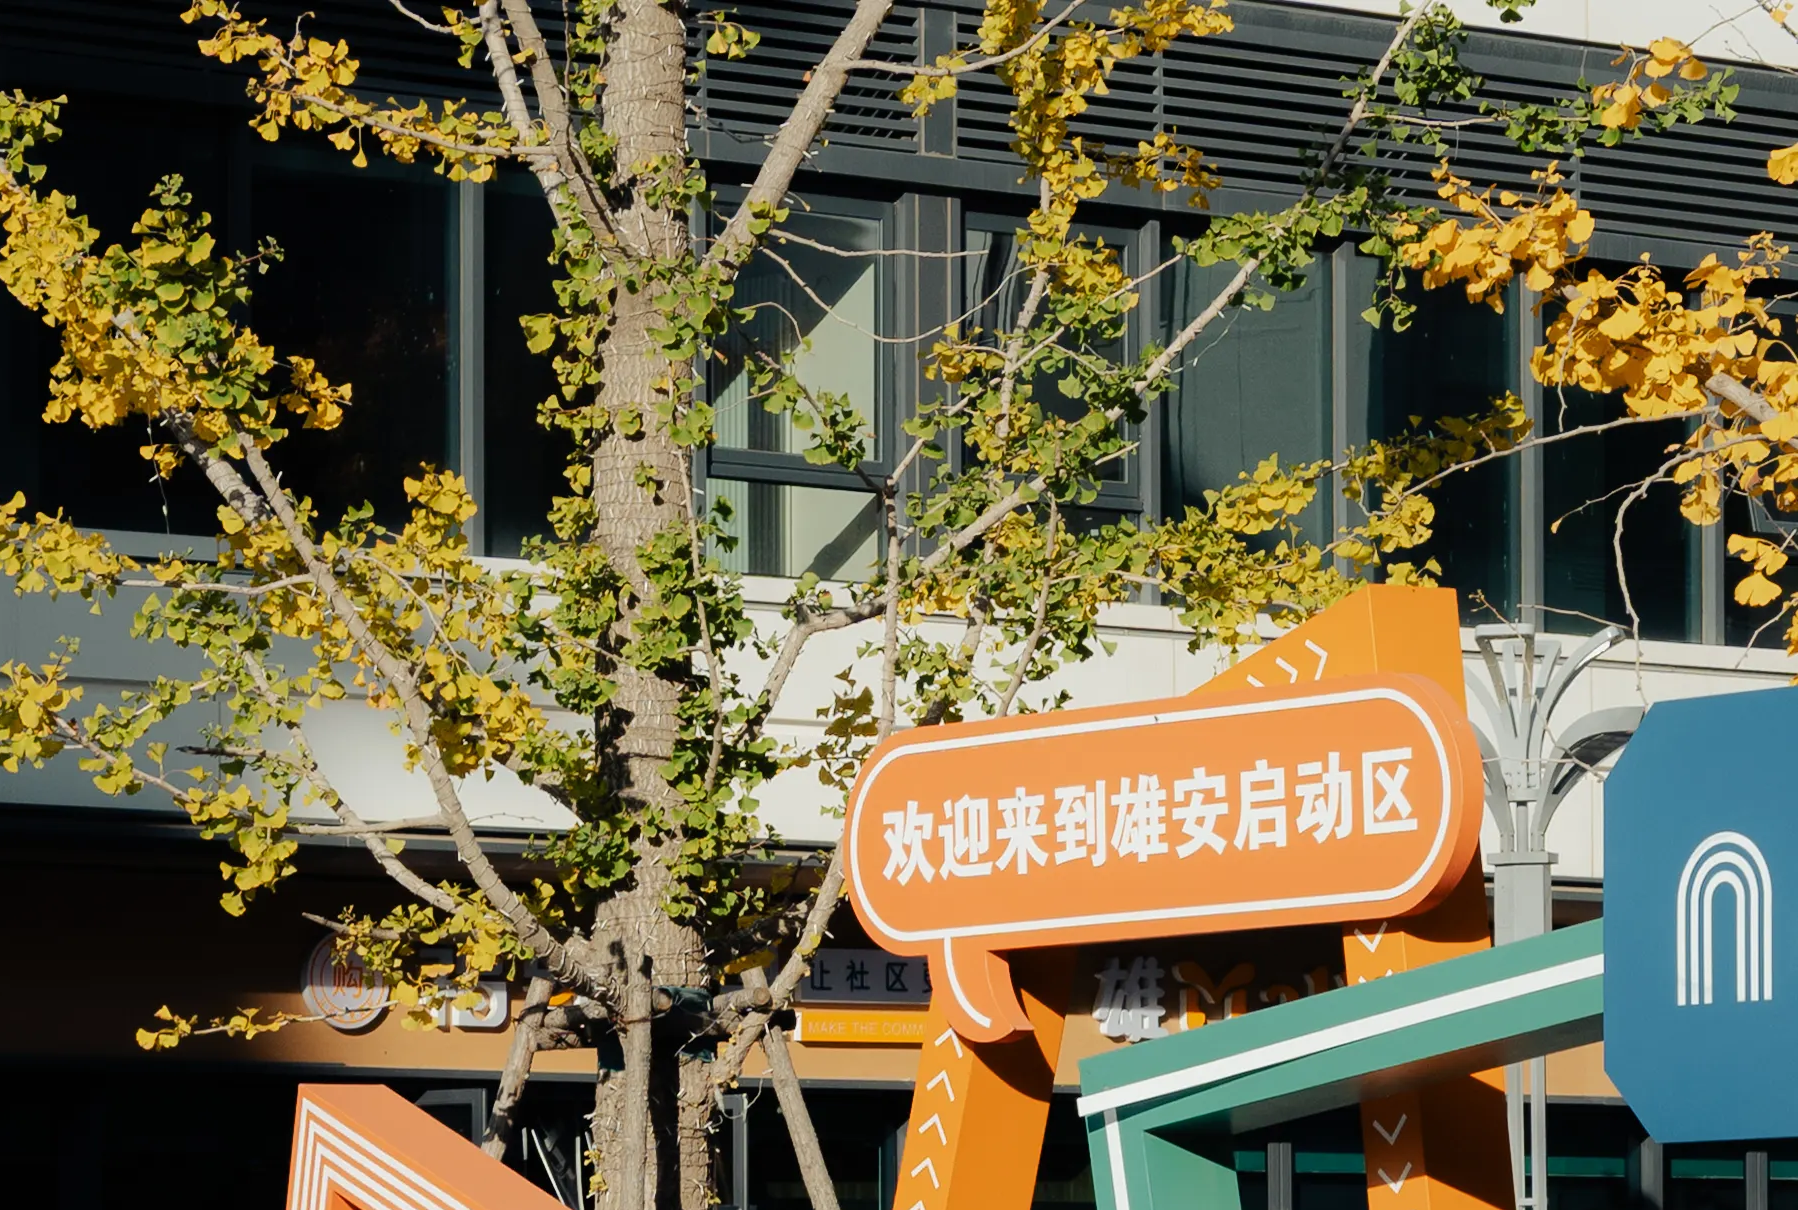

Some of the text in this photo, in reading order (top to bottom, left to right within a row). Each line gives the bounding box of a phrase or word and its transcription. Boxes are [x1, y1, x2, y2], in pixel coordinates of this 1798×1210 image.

[881, 746, 1419, 887] 欢迎来到雄安启动区
[808, 1021, 847, 1036] MAKE
[852, 1022, 876, 1036] THE
